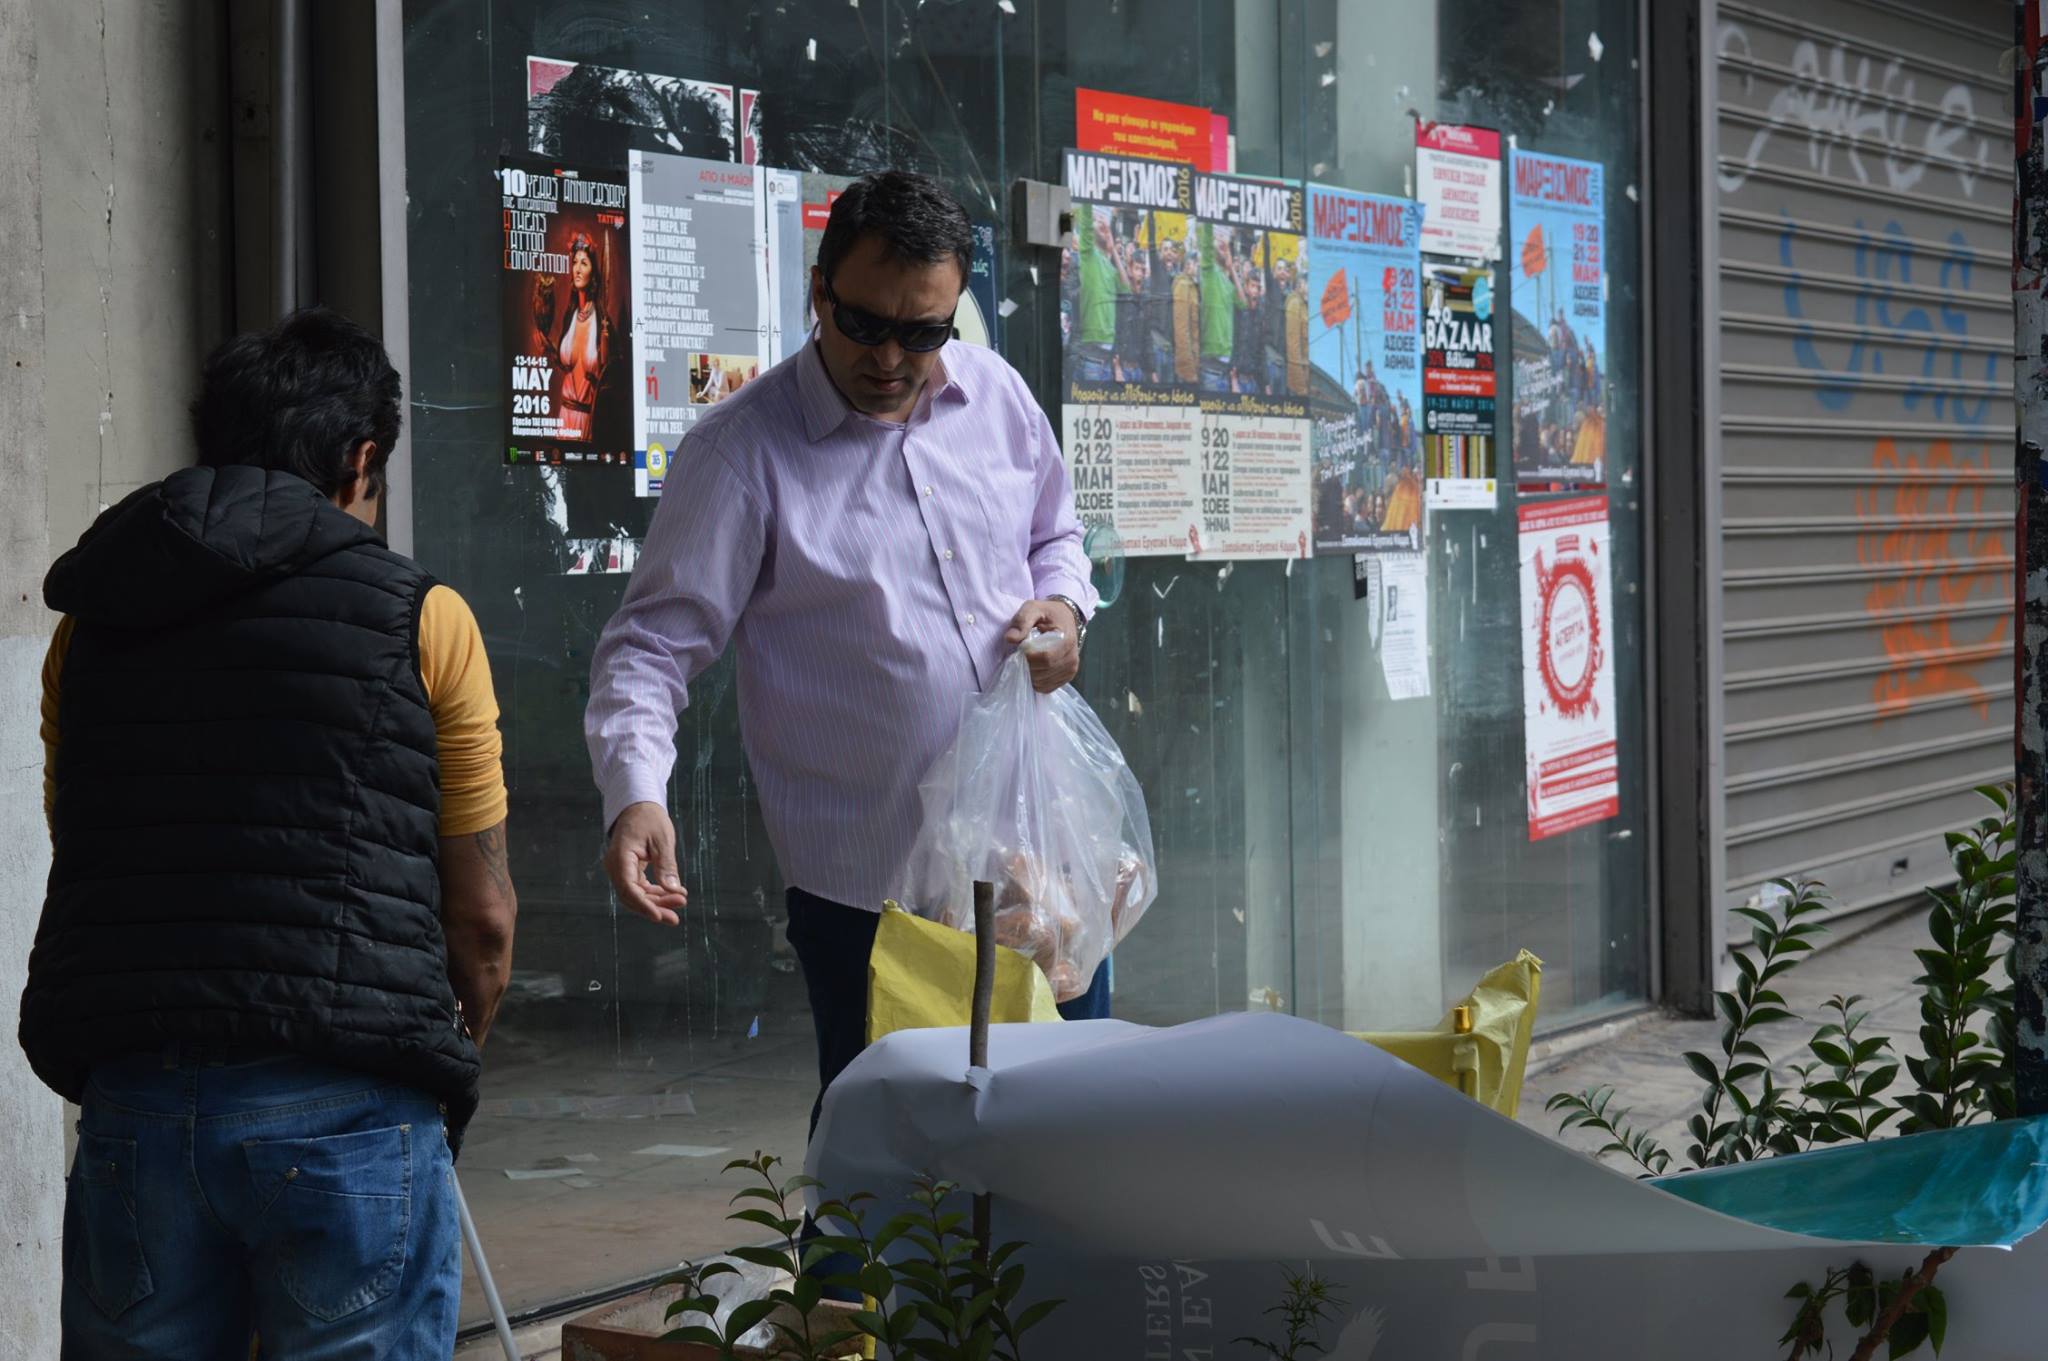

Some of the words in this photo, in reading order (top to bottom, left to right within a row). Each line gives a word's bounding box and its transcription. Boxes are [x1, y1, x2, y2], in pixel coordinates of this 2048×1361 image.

[698, 169, 718, 184] ΑΠΟ
[720, 172, 726, 182] 4
[1067, 154, 1178, 208] ΜΑΡΞΙΣΜΟΣ
[1178, 167, 1191, 209] 2016
[1515, 156, 1592, 207] ΜΑΡΞΙΣΜΟΣ
[501, 168, 527, 197] 10
[526, 174, 559, 201] YEARS
[563, 179, 627, 209] ANNIVERSARY
[1195, 176, 1291, 229] ΜΑΡΞΙΣΜΟΣ
[1291, 191, 1302, 231] 2016
[503, 209, 547, 232] ATHENS
[1313, 192, 1404, 247] ΜΑΡΞΙΣΜΟΣ
[504, 229, 545, 252] TATTOO
[503, 249, 570, 274] CONVENTION
[1400, 268, 1414, 288] 20
[1572, 263, 1600, 284] ΜΑΗ
[1384, 289, 1397, 308] 21
[1401, 290, 1415, 310] 22
[1384, 310, 1415, 333] ΜΑΗ
[1384, 335, 1416, 352] ΑΣΟΕΕ
[1426, 318, 1493, 353] BAZAAR
[515, 355, 548, 367] 13-14-15
[1384, 354, 1416, 370] ΑΘΗΝΑ
[512, 366, 553, 391] MAY
[647, 366, 658, 400] ή
[513, 394, 551, 415] 2016
[1073, 418, 1091, 440] 19
[1093, 417, 1112, 440] 20
[1212, 427, 1229, 448] 20
[1074, 442, 1091, 465] 21
[1094, 442, 1113, 464] 22
[1213, 450, 1229, 471] 22
[1074, 466, 1113, 490] ΜΑΗ
[1075, 493, 1114, 510] ΑΣΟΕΕ
